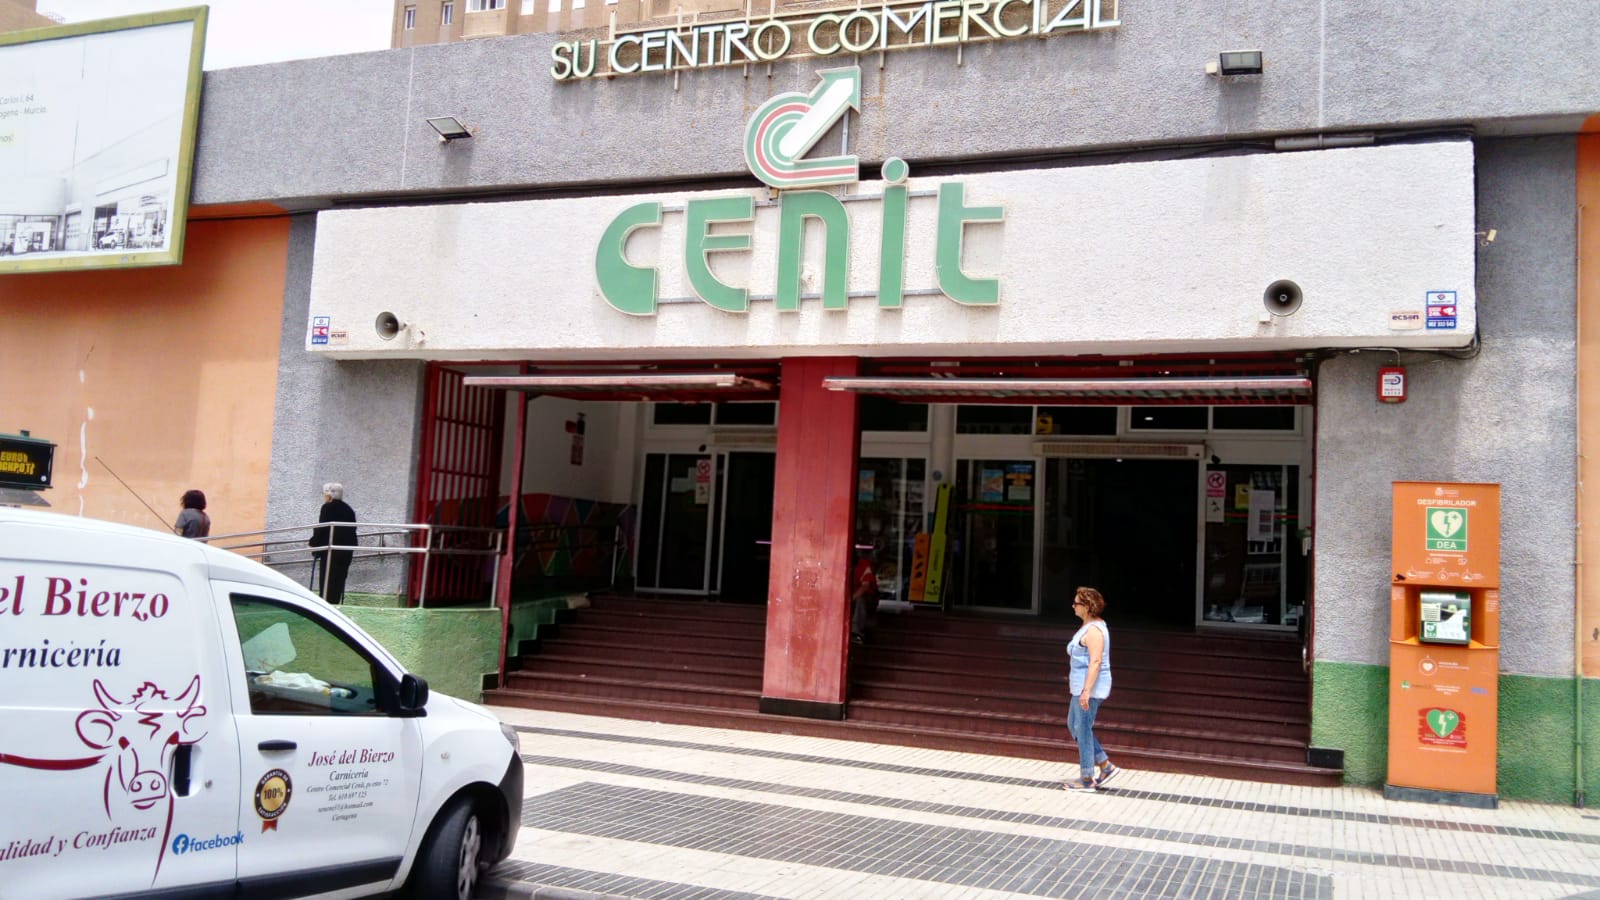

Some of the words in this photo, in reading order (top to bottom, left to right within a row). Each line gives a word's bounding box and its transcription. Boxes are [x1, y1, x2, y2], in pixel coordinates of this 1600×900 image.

[551, 39, 598, 80] SU
[610, 19, 792, 74] CENTRO
[808, 0, 1121, 55] COMERCIAL
[1417, 498, 1477, 506] DESFIBRILADOR
[1436, 541, 1457, 549] DEA
[41, 576, 169, 622] Bierzo
[308, 750, 336, 767] José
[339, 749, 356, 764] del
[360, 748, 395, 764] Bierzo
[264, 787, 284, 800] 100%
[53, 839, 68, 859] y
[73, 825, 157, 852] Confianza
[189, 832, 244, 852] facebook
